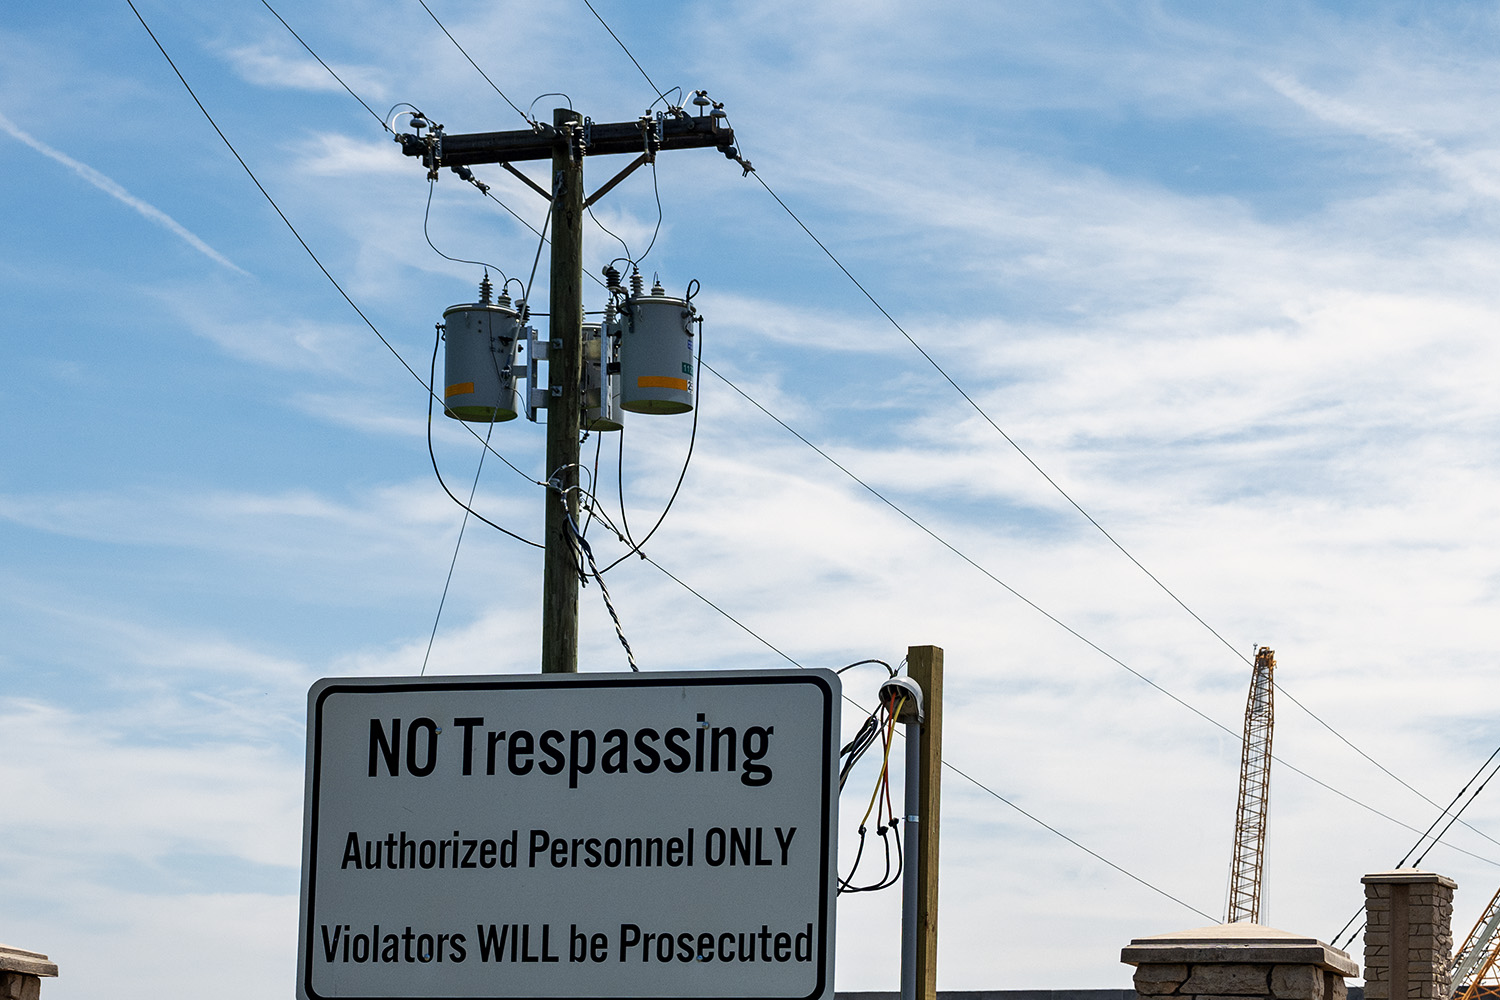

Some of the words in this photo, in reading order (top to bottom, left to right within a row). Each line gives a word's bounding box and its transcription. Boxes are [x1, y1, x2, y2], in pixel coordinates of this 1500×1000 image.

[368, 717, 438, 778] NO
[453, 713, 774, 789] Trespassing
[340, 829, 518, 870] Authorized
[528, 827, 694, 868] Personnel
[705, 827, 797, 867] ONLY
[320, 924, 467, 964] Violators
[476, 923, 560, 963] WILL
[569, 923, 608, 963] be
[619, 922, 813, 963] Prosecuted
